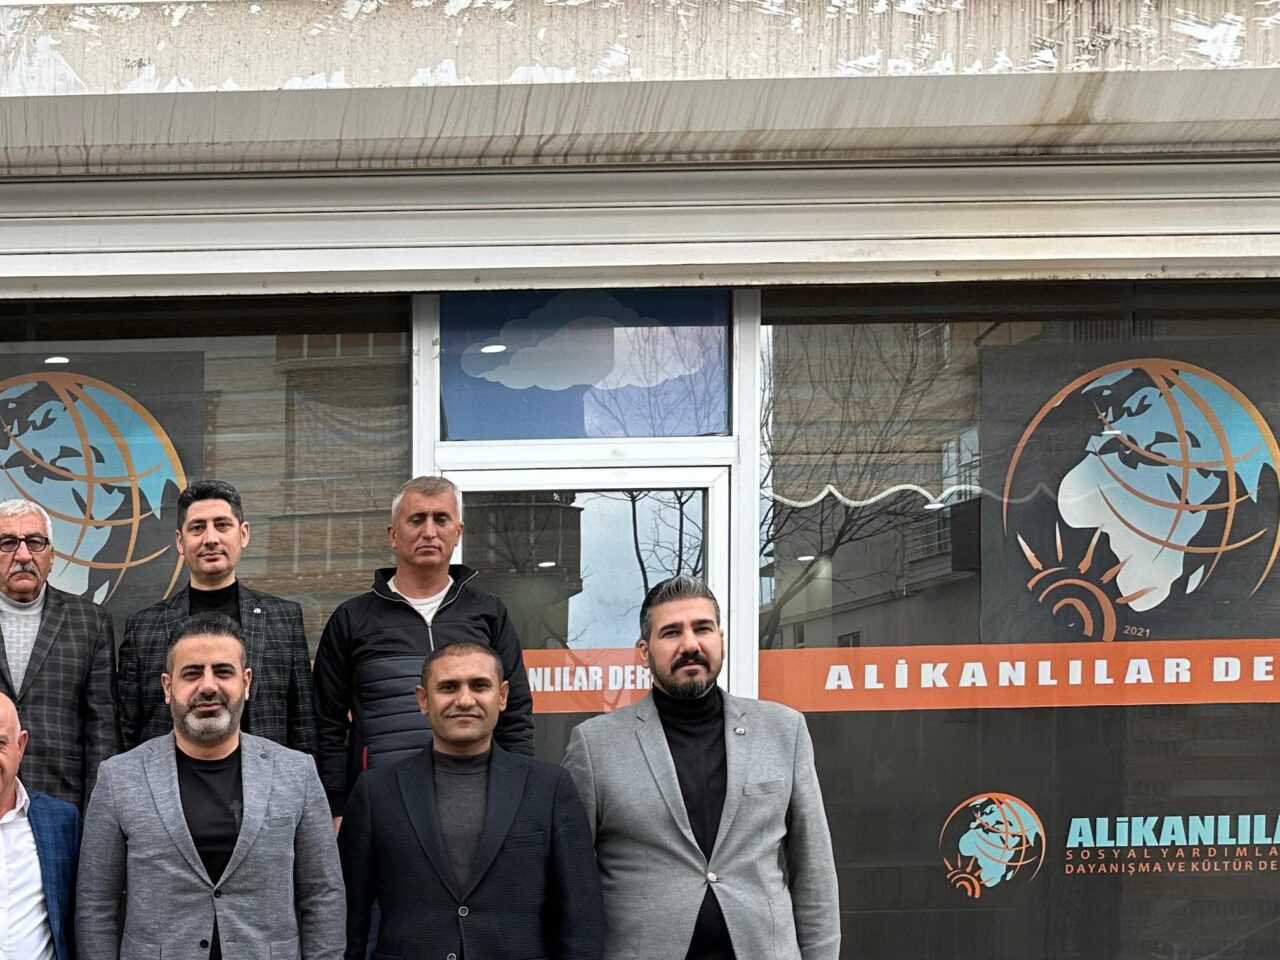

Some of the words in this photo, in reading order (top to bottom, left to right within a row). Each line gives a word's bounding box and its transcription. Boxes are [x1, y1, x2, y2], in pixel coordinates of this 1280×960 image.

[1123, 625, 1150, 638] 2021
[528, 666, 603, 692] NLILAR
[608, 665, 654, 690] DER
[825, 659, 1191, 690] ALİKANLILAR
[1213, 656, 1275, 682] DE
[1065, 848, 1151, 860] SOSYAL
[1065, 862, 1162, 876] DAYANIŞMA
[1167, 862, 1185, 872] VE
[1191, 860, 1253, 872] KÜLTÜR
[1258, 861, 1278, 871] DE
